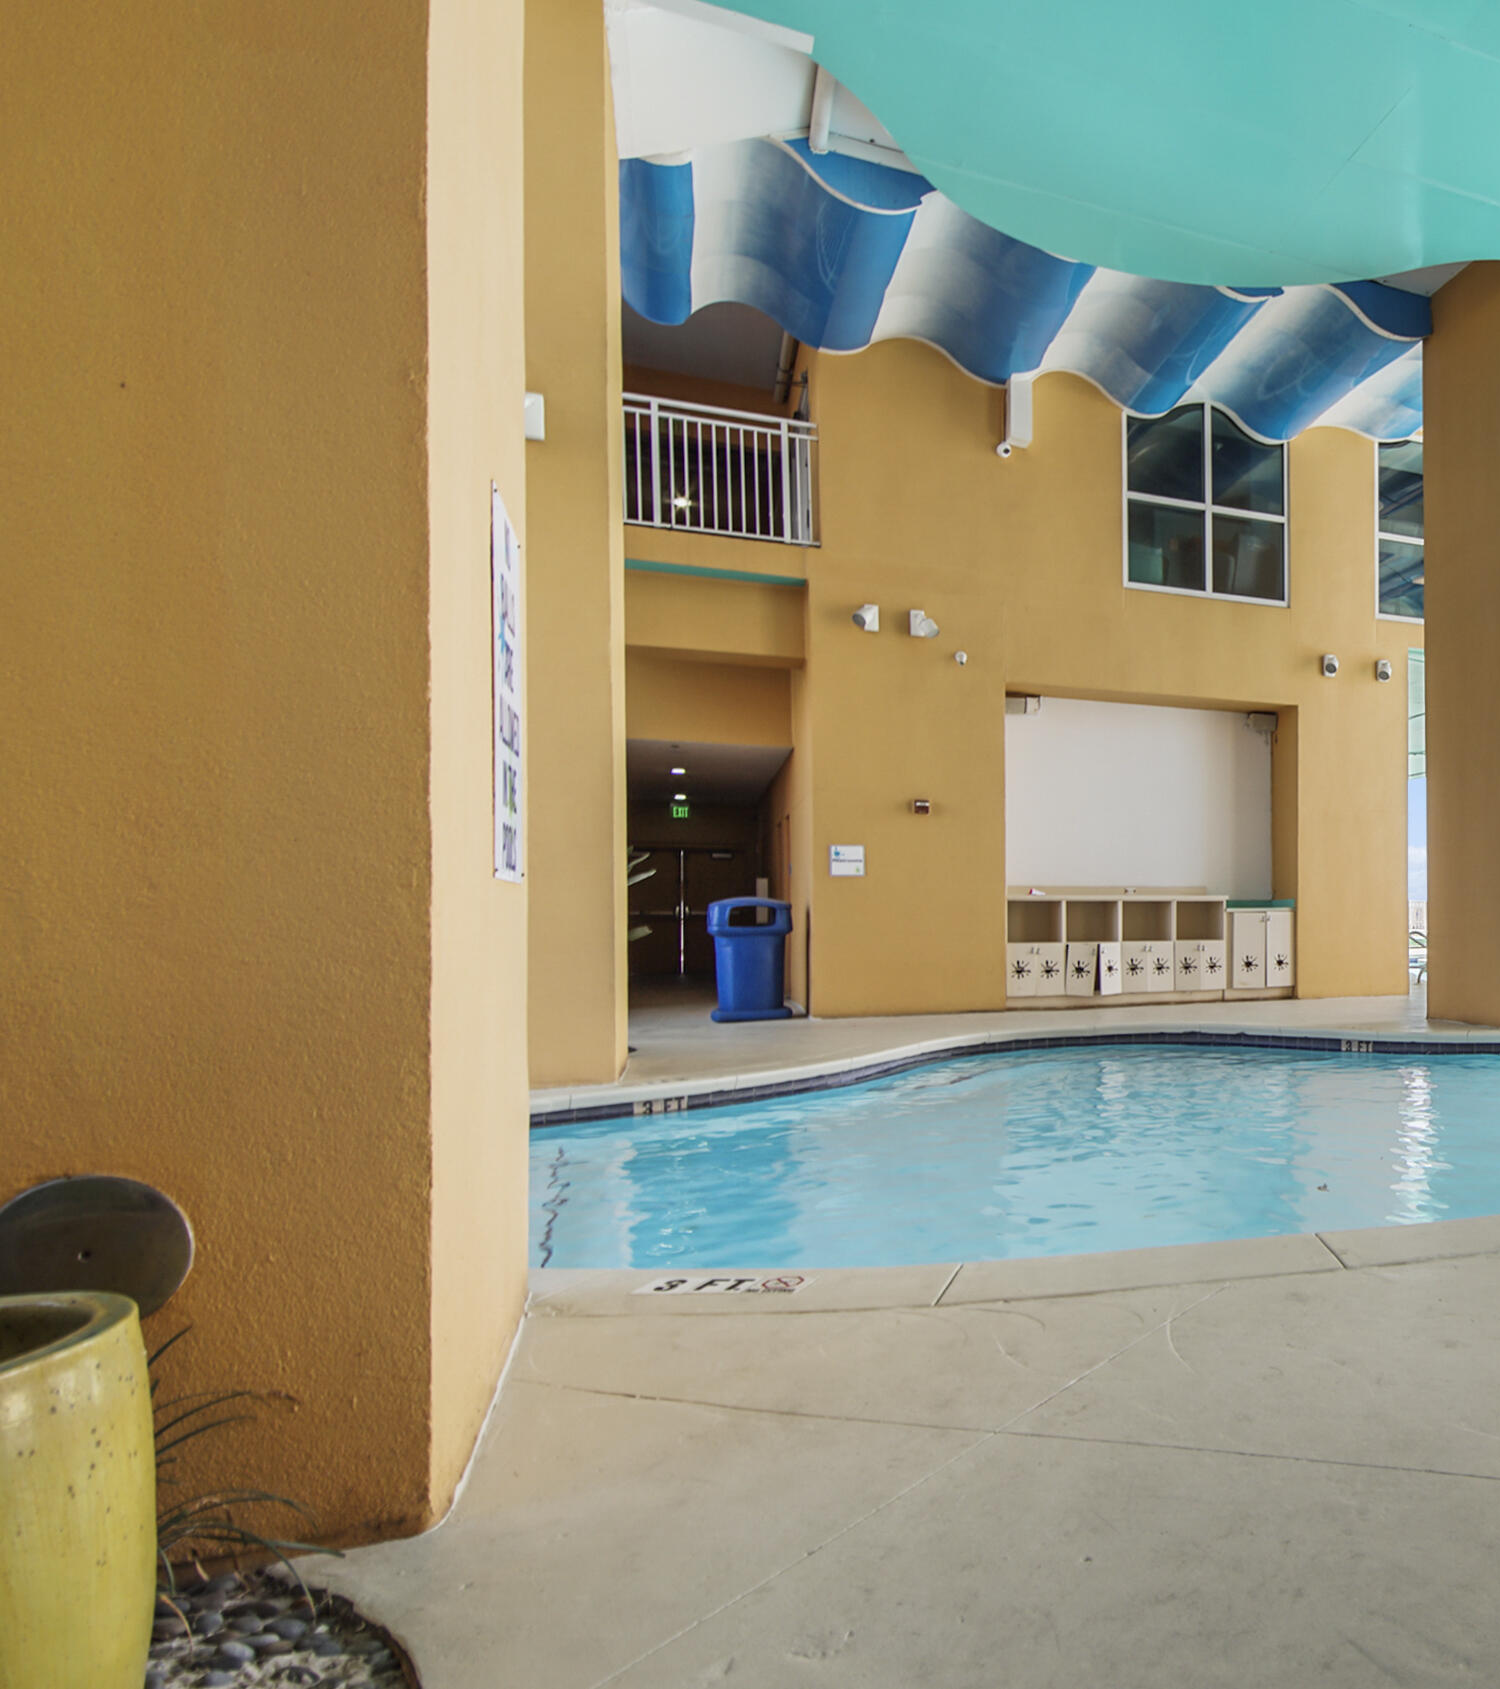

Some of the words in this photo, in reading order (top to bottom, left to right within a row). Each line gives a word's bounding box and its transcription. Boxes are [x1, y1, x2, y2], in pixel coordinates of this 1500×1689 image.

[672, 806, 689, 818] EXIT
[642, 1100, 653, 1115] 3
[663, 1096, 685, 1112] FT
[653, 1279, 688, 1292] 3
